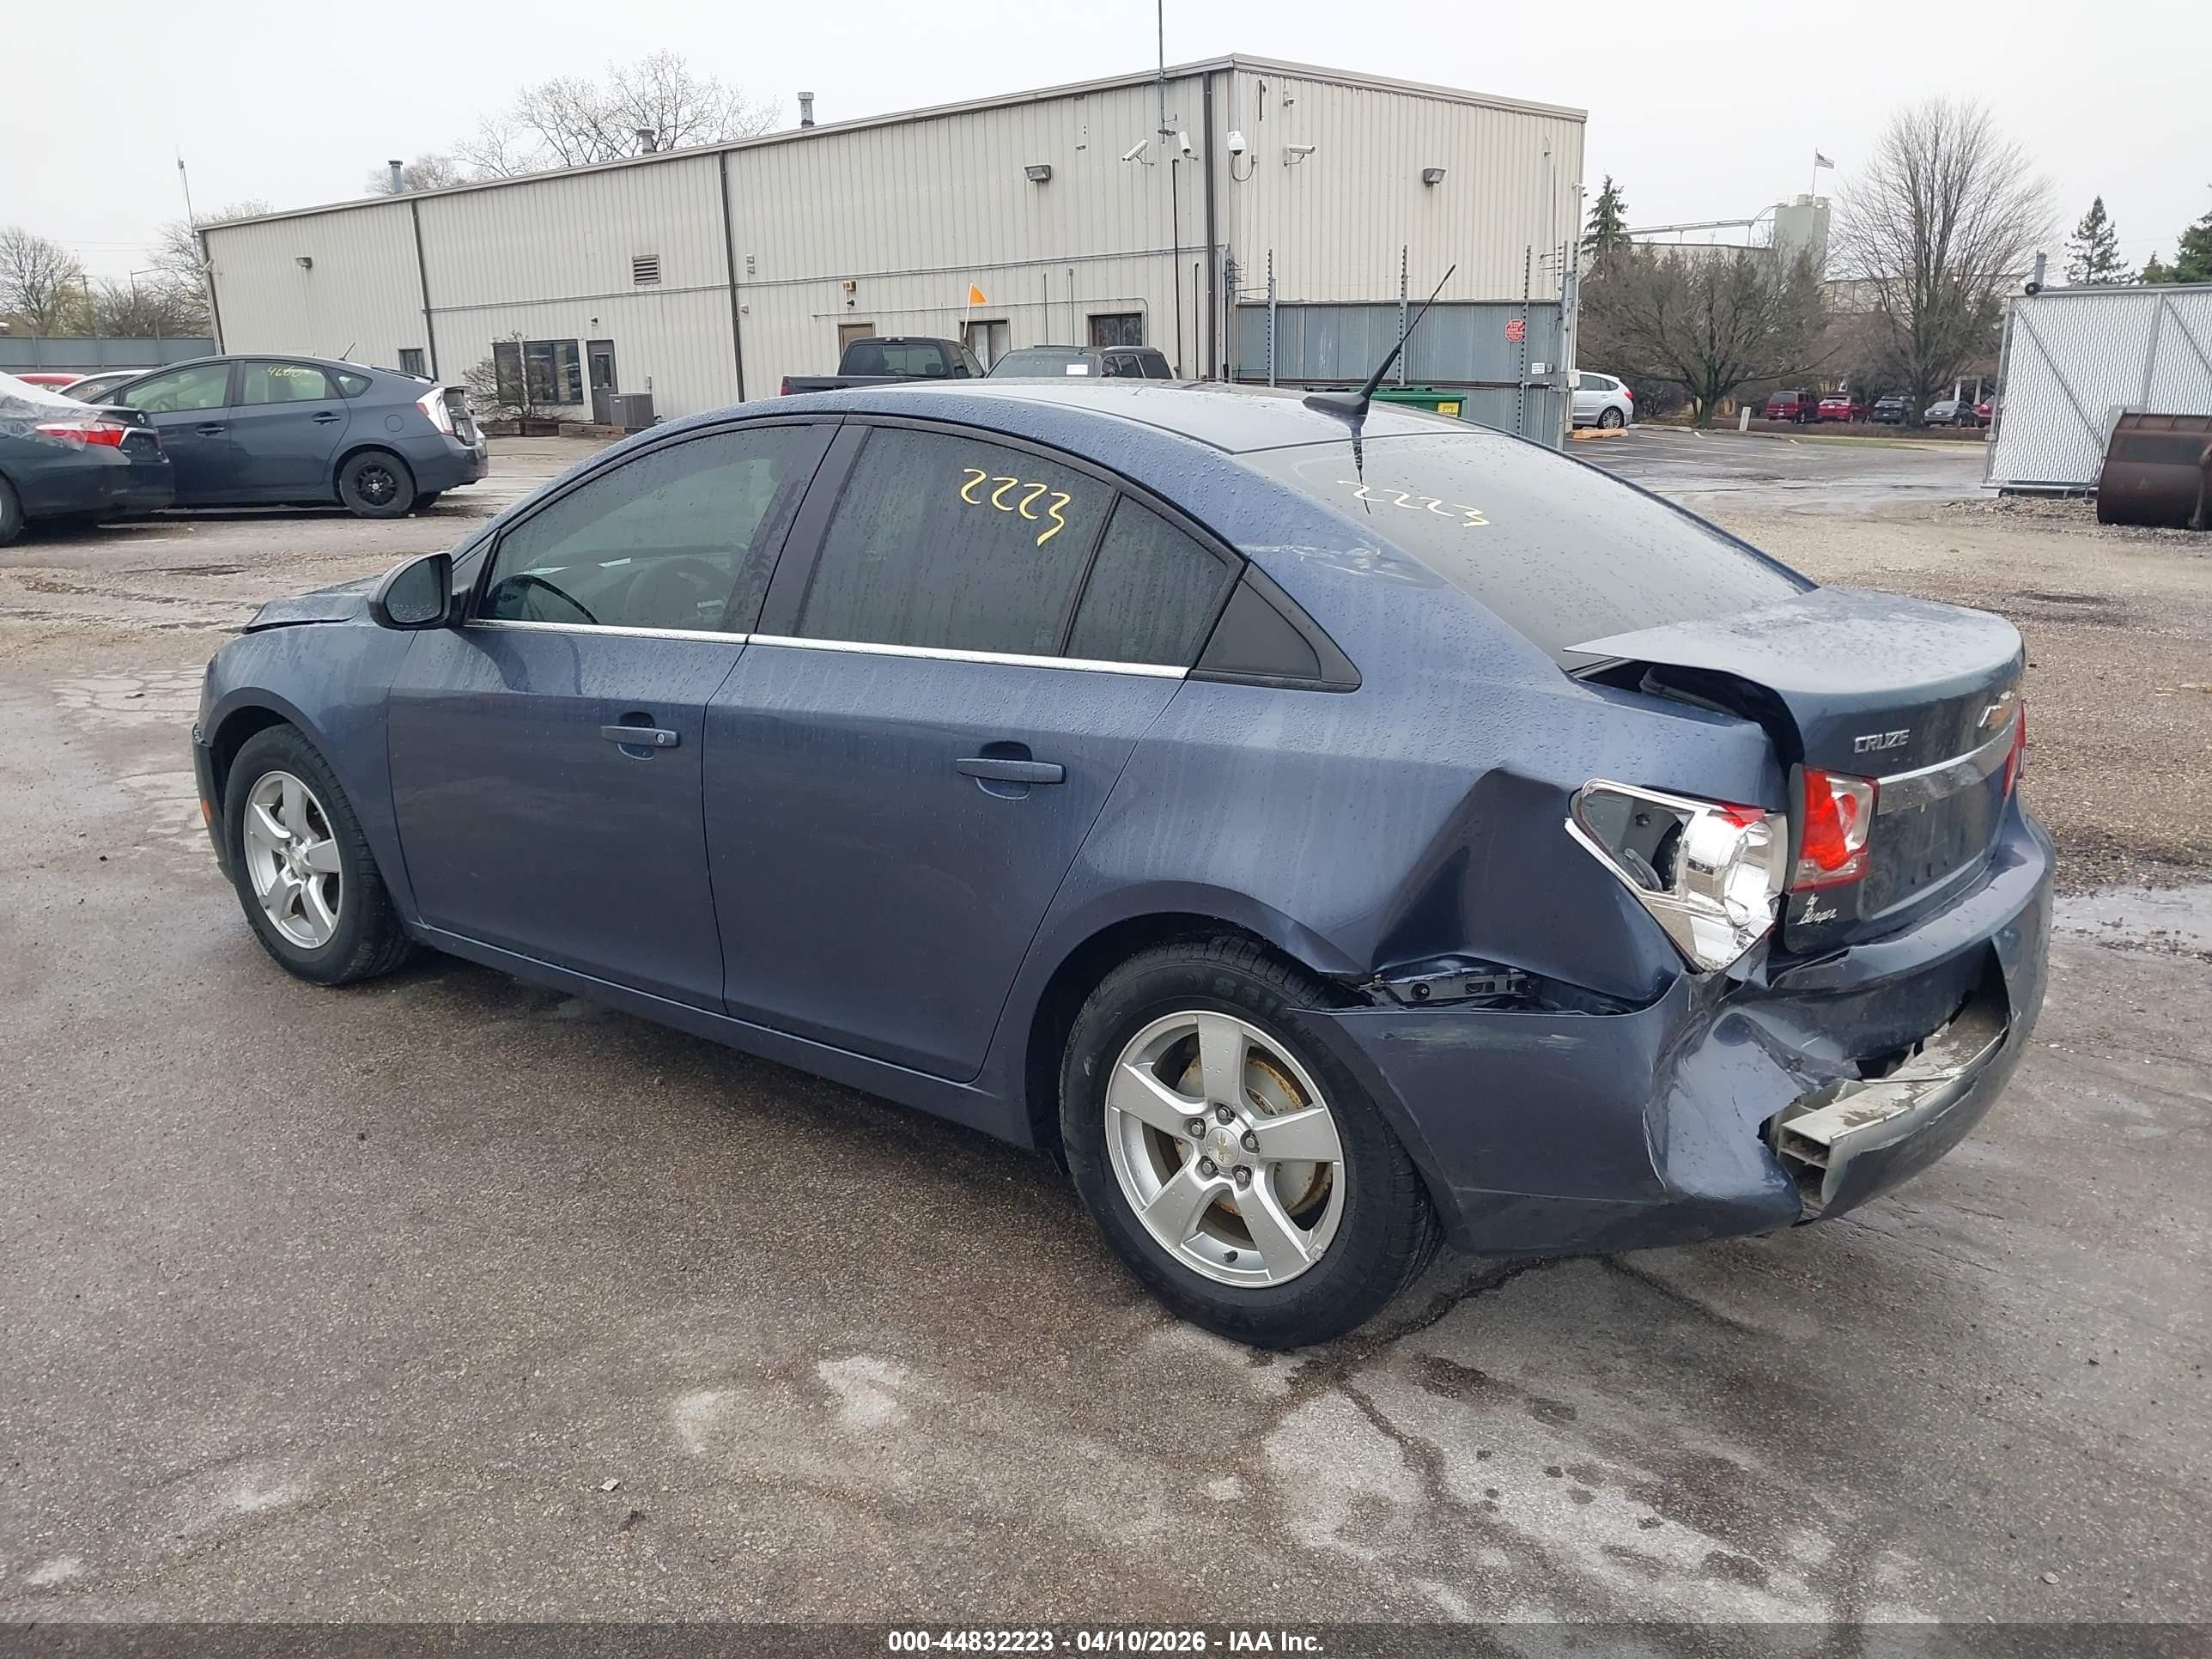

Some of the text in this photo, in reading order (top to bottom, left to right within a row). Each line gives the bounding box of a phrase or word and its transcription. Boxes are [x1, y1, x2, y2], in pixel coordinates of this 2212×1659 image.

[961, 468, 1071, 547] 2223
[1336, 480, 1490, 528] 2223
[1855, 728, 1911, 753] CRUZE
